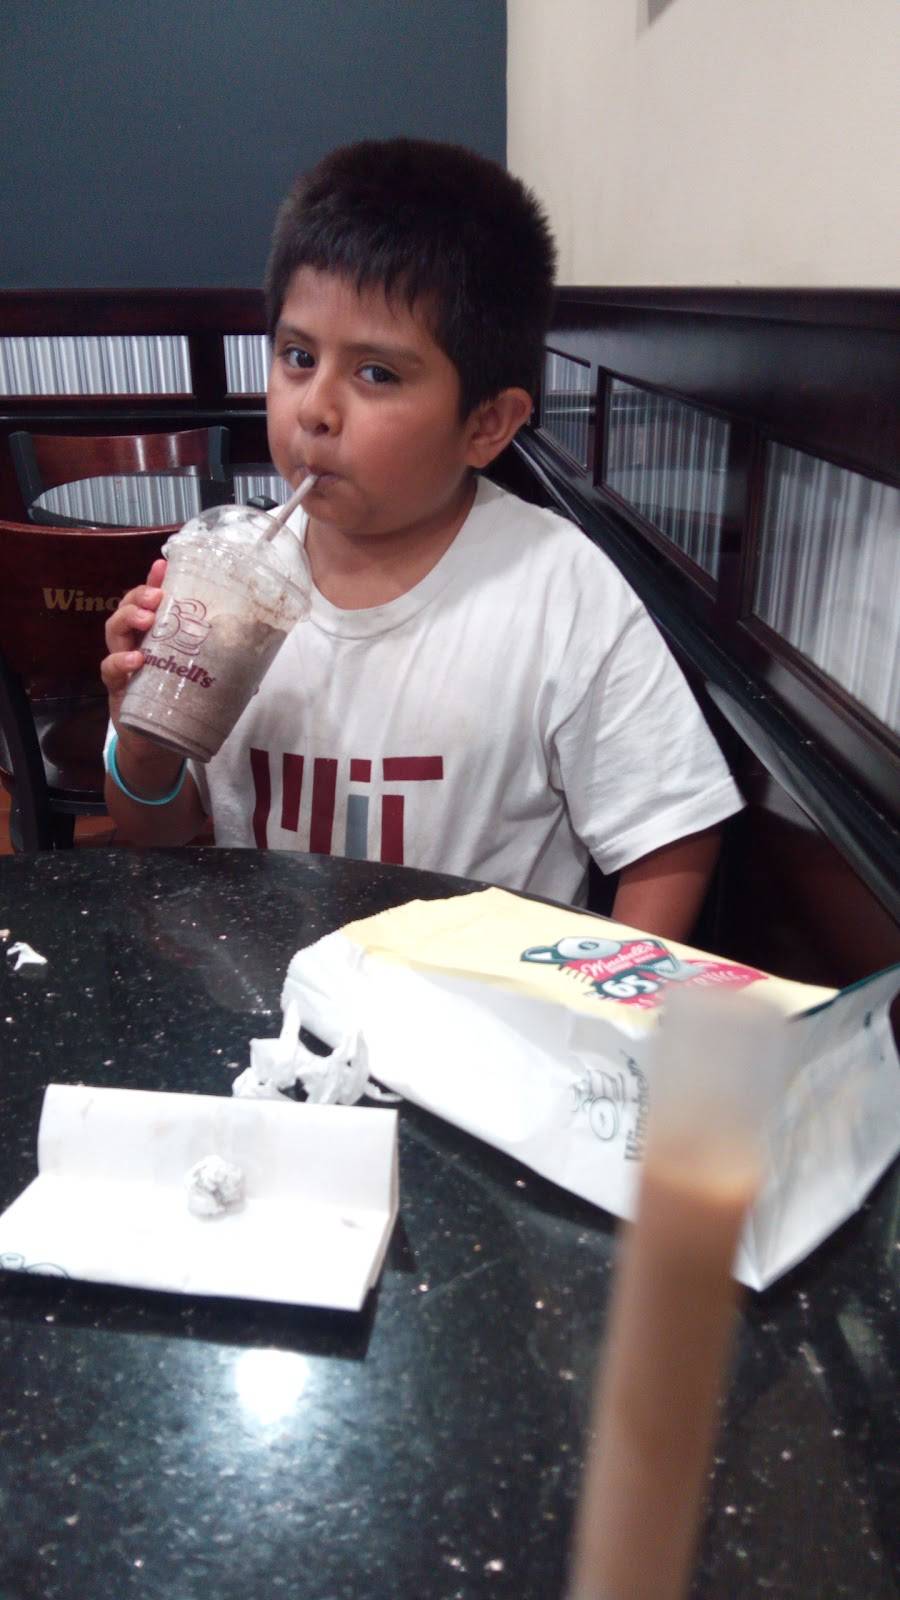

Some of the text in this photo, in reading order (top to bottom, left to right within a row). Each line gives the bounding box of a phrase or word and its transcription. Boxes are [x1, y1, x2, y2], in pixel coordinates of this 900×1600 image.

[42, 587, 125, 611] Winc
[140, 648, 213, 688] inchell's
[250, 747, 443, 865] MIT
[602, 975, 659, 997] 65
